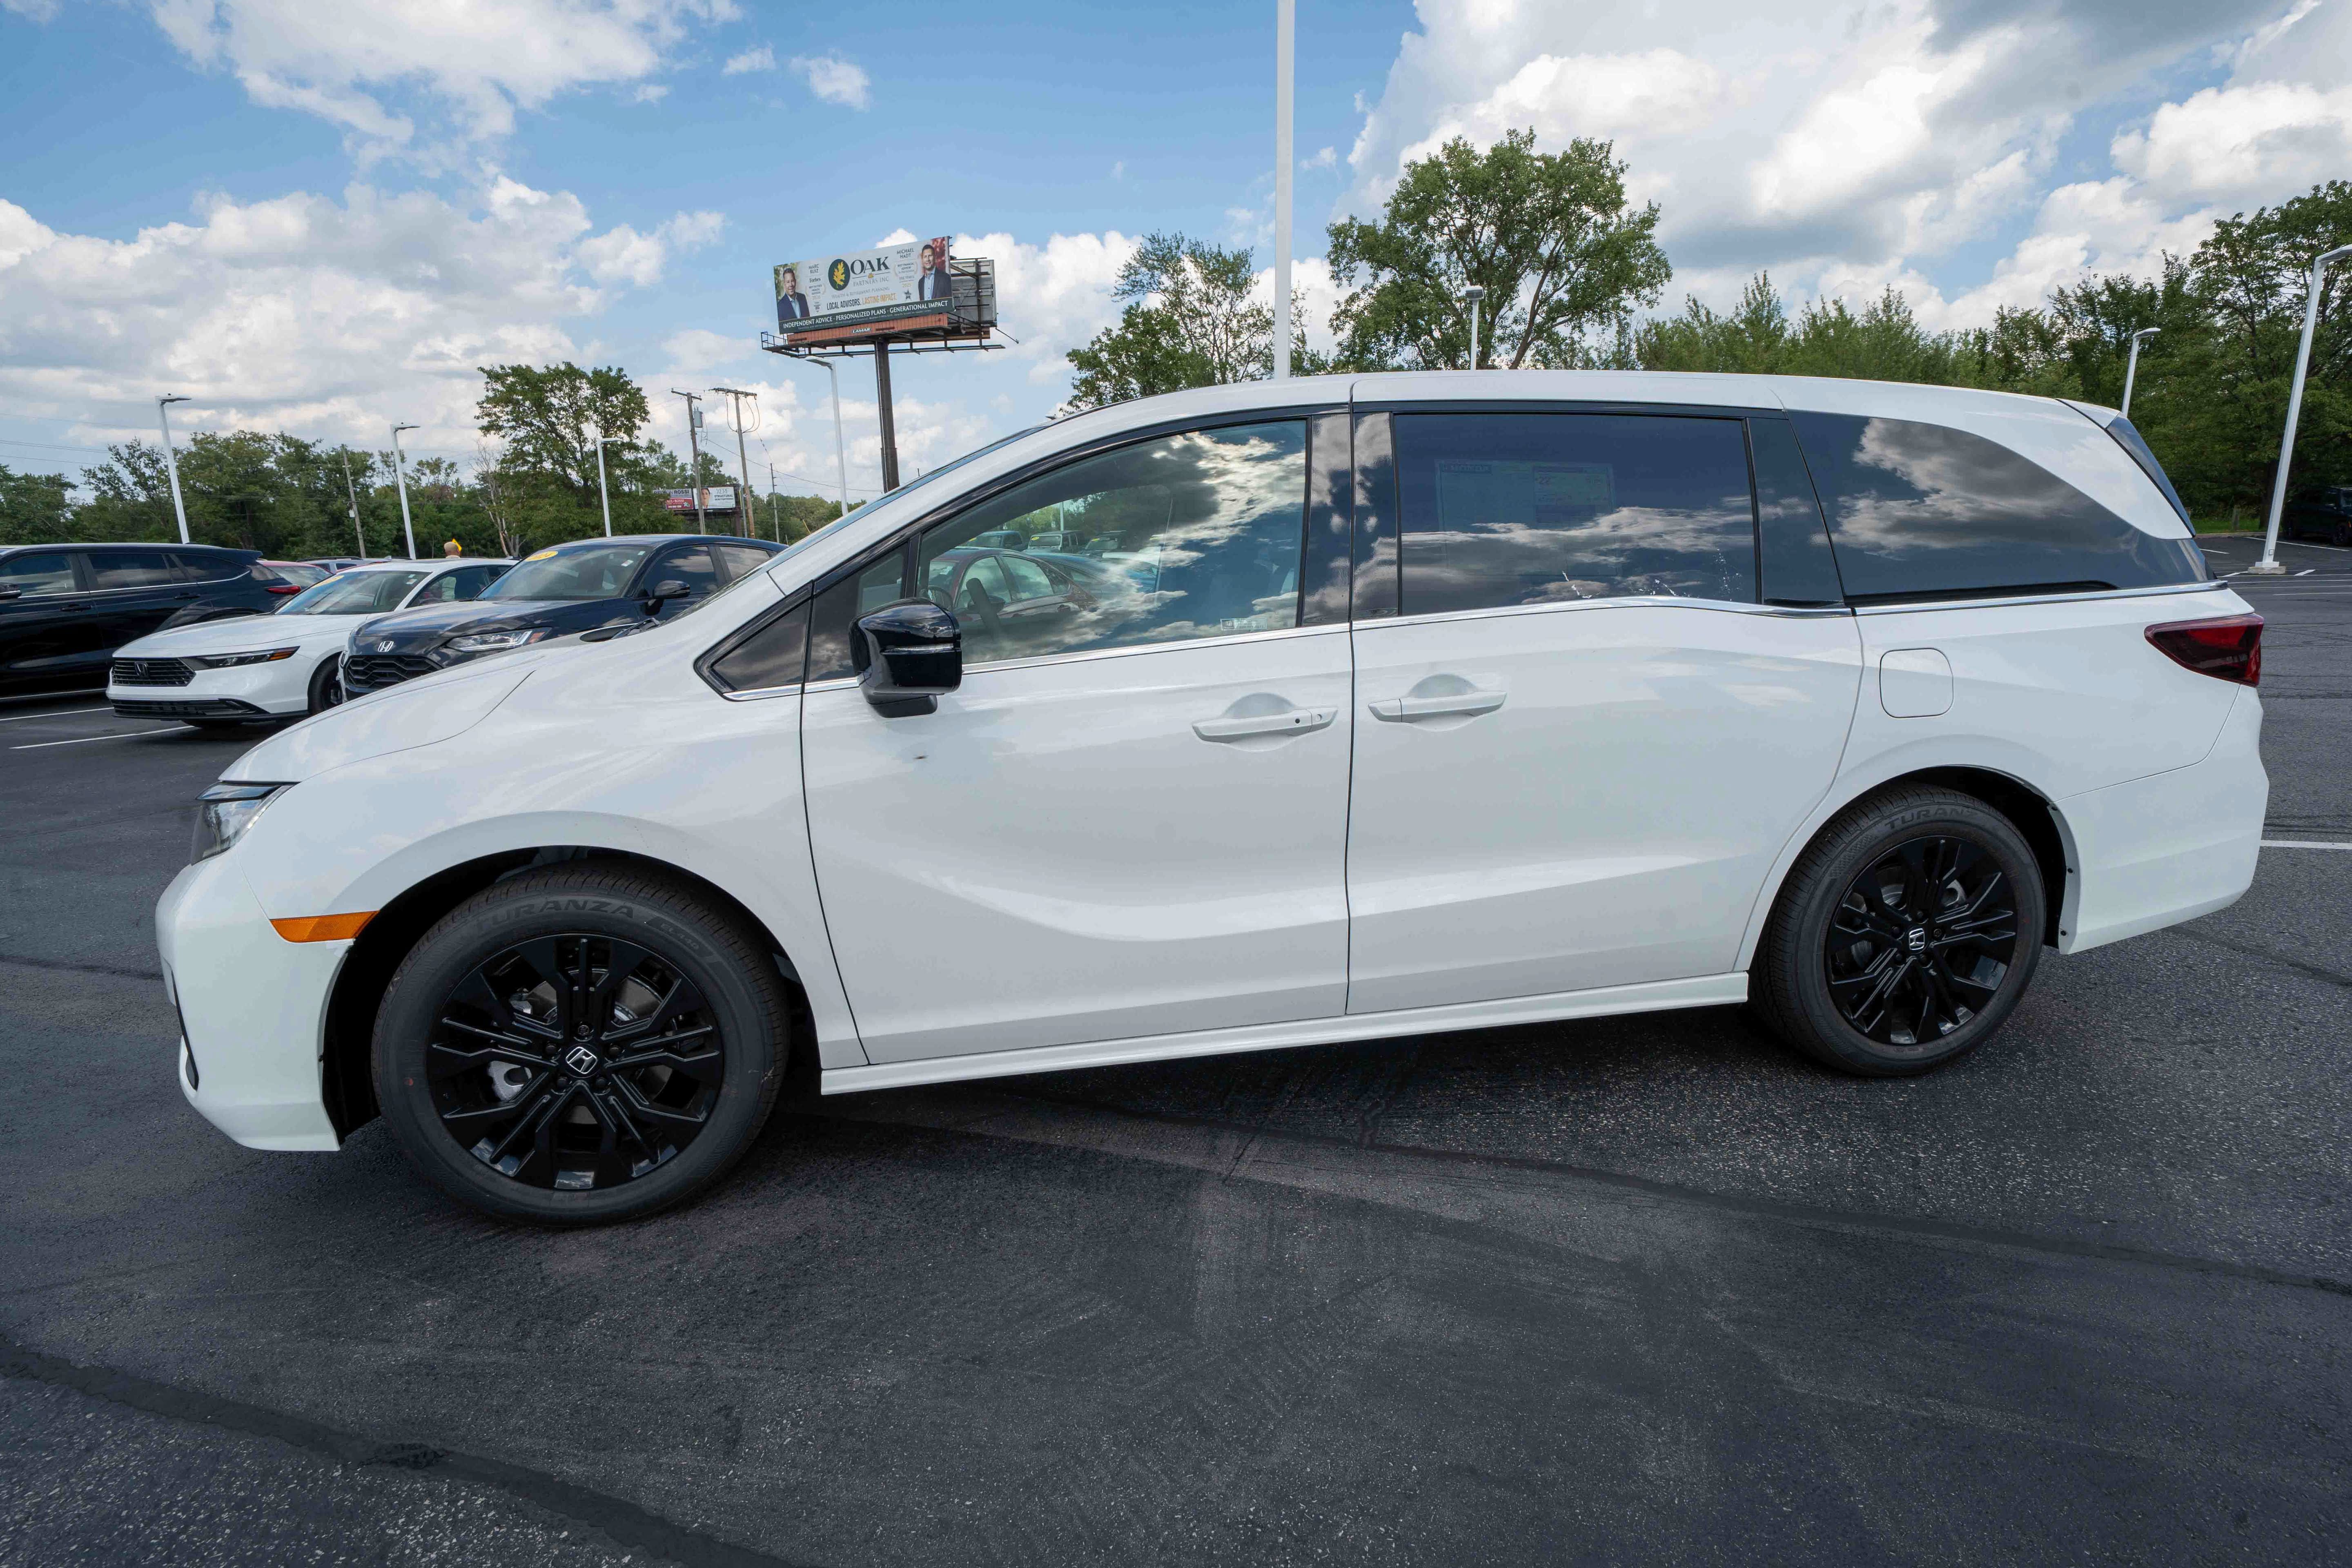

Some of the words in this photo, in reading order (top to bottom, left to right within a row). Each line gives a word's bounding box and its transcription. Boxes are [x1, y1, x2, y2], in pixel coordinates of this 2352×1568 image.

[850, 256, 891, 275] OAK
[853, 278, 878, 287] PARTNERS
[826, 302, 839, 310] LOCAL
[862, 295, 880, 305] LASTING
[783, 319, 815, 329] INDEPENDENT
[836, 312, 870, 321] PERSONALIZED
[889, 303, 928, 313] GENERATIONAL
[475, 899, 635, 933] TURANZA
